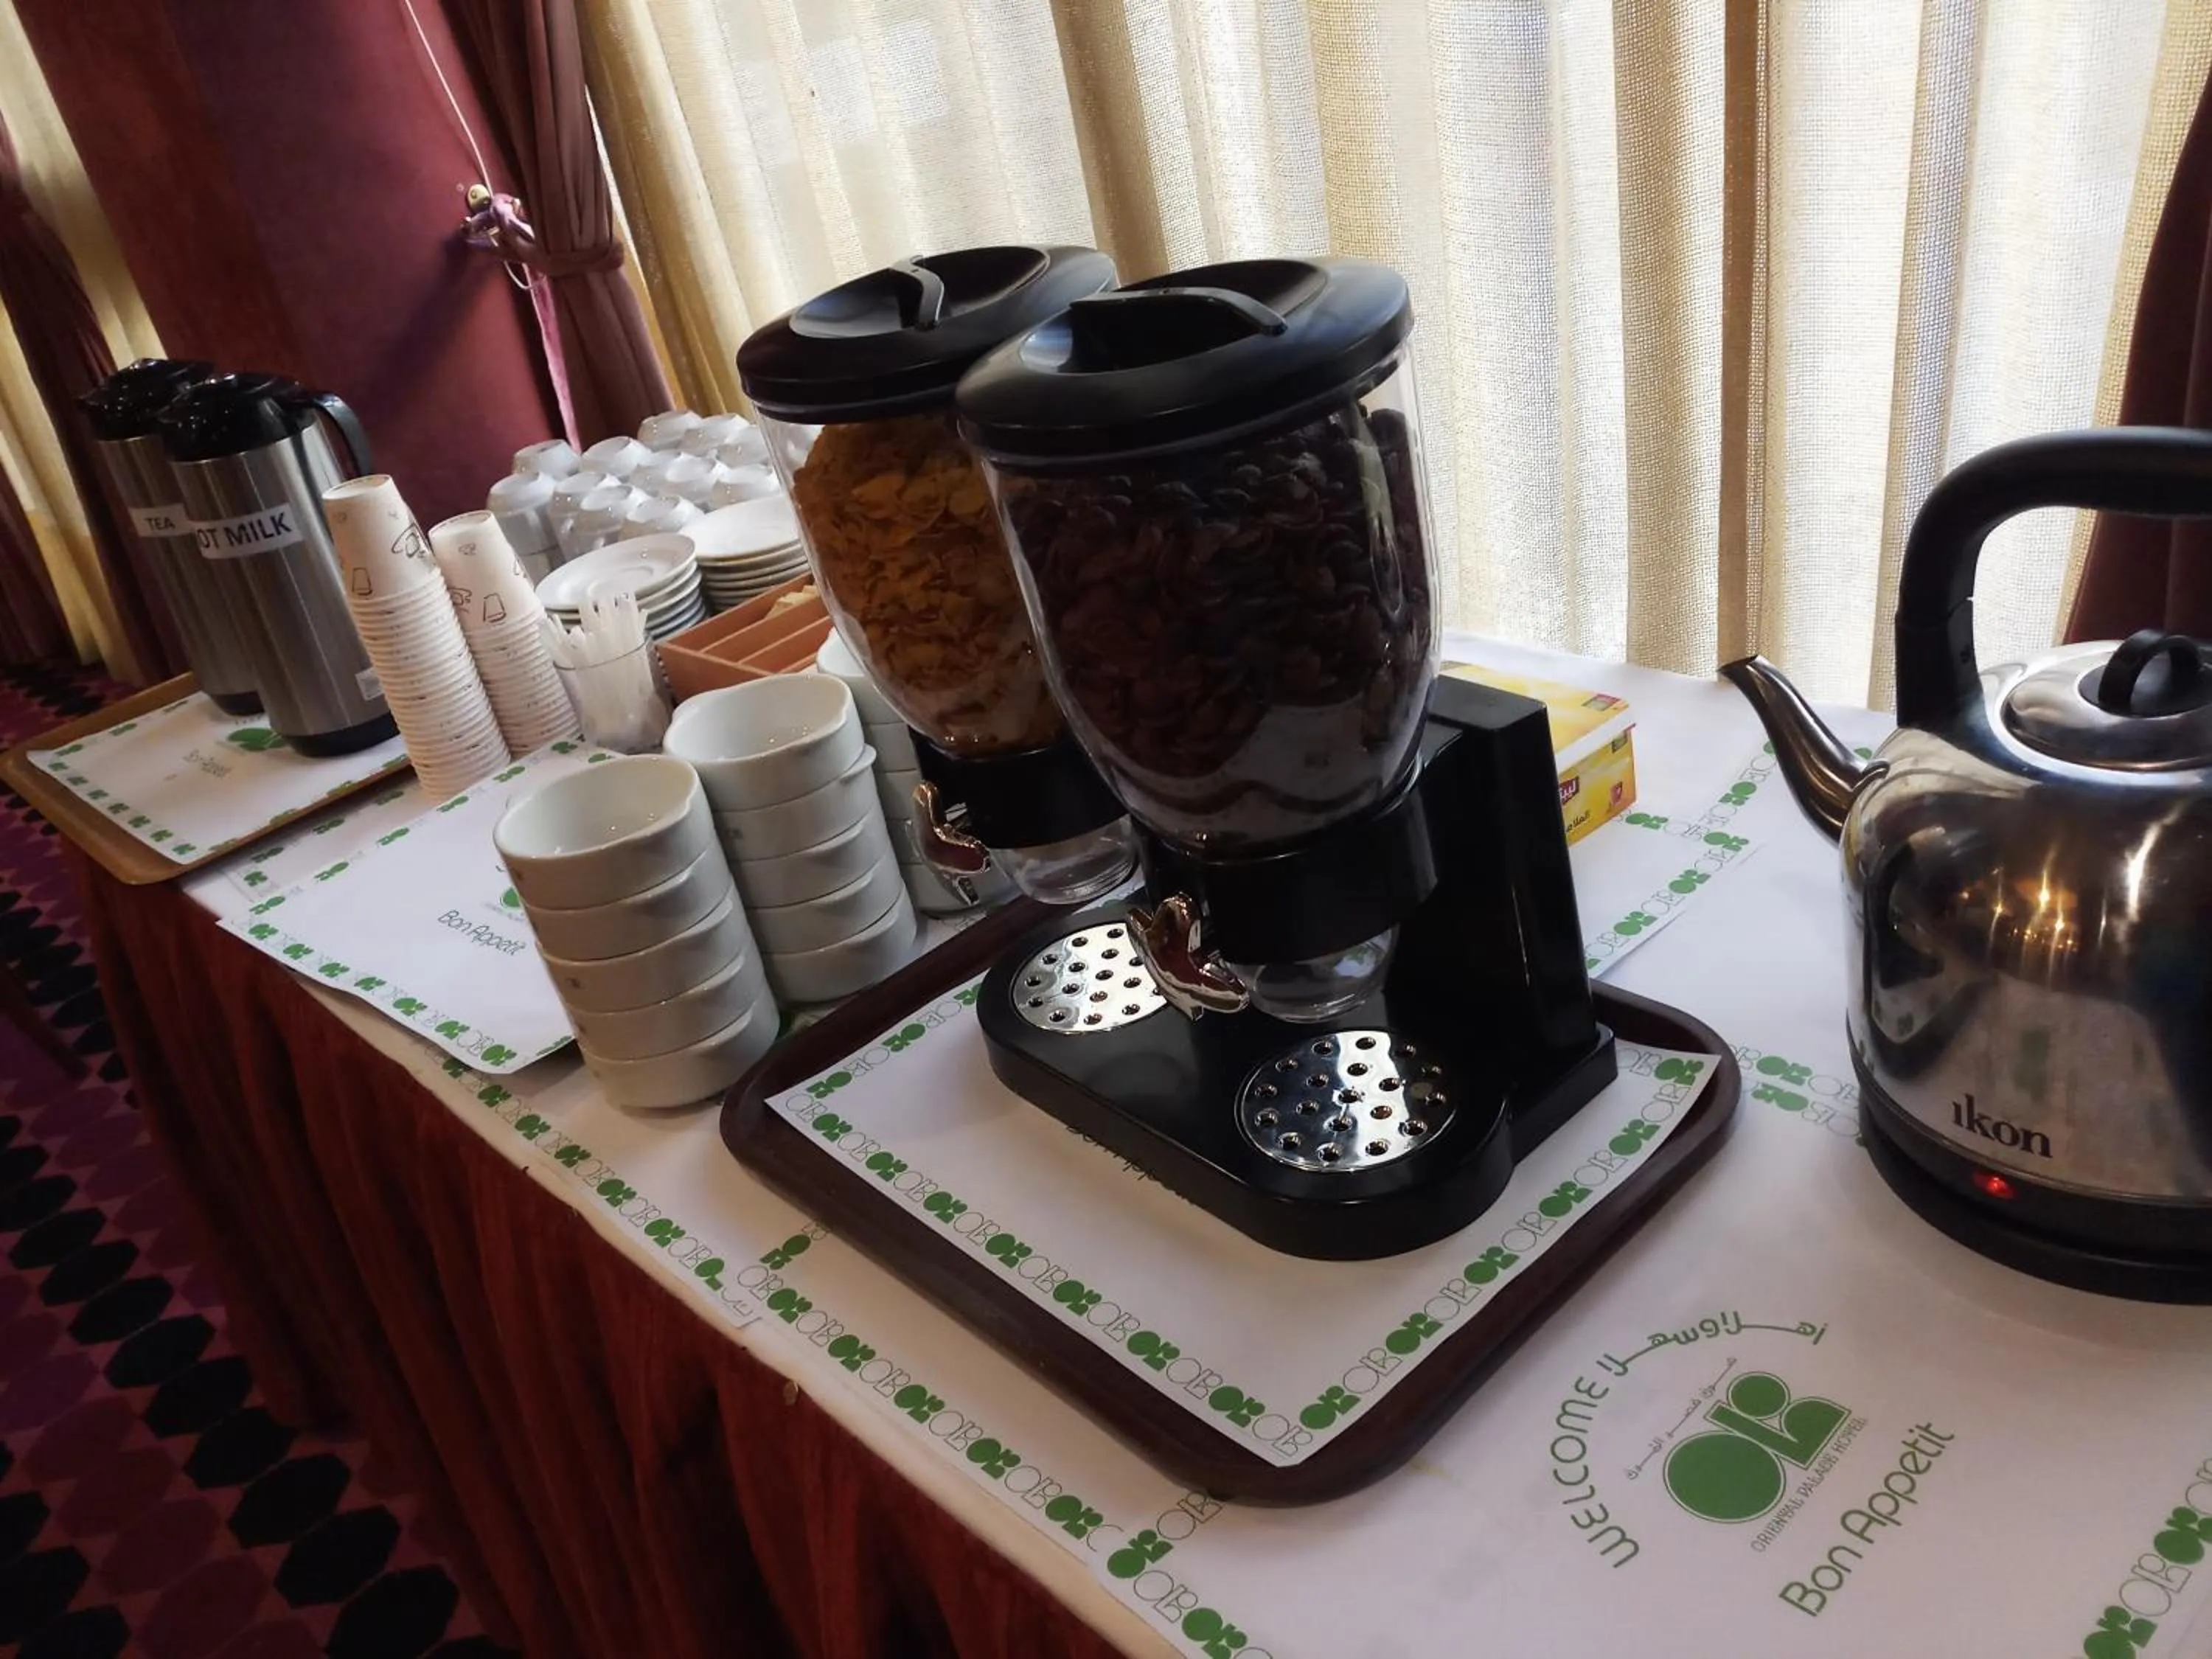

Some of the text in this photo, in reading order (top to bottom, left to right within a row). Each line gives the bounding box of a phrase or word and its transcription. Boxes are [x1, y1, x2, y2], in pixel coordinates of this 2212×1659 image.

[145, 516, 175, 531] TEA
[196, 512, 292, 550] OT MILK
[437, 909, 472, 933] Bon
[1952, 1093, 2053, 1159] ikon
[1551, 1375, 1640, 1569] WELCOME
[1778, 1422, 1955, 1617] Bon Appetit
